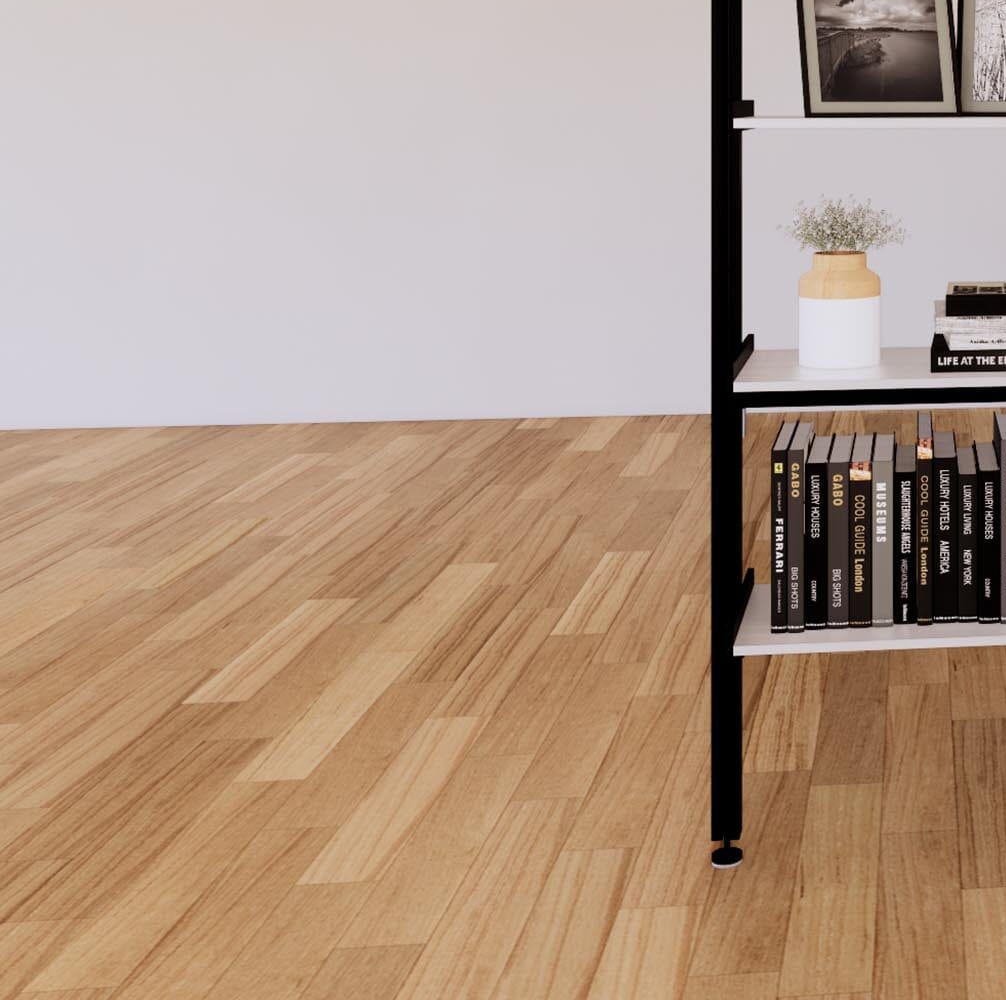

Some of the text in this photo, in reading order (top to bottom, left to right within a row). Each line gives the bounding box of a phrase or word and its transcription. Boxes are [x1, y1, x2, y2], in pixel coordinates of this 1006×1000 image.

[937, 356, 959, 366] LIFE
[960, 356, 973, 366] AT
[975, 355, 996, 365] THE
[791, 463, 800, 498] GABO
[810, 475, 820, 538] LUXURY HOUSES
[833, 474, 843, 506] GABO
[876, 482, 887, 543] MUSEUMS
[920, 475, 929, 585] COOL GUIDE London
[939, 469, 950, 574] LUXURY HOTELS AMERICA
[963, 485, 972, 585] LUXURY LIVING NEW YORK
[984, 481, 993, 540] LUXURY HOUSES
[775, 518, 784, 573] FERRARI
[854, 495, 865, 592] COOL GUIDE London
[901, 532, 911, 553] ANGELS
[832, 569, 841, 608] BIG SHOTS
